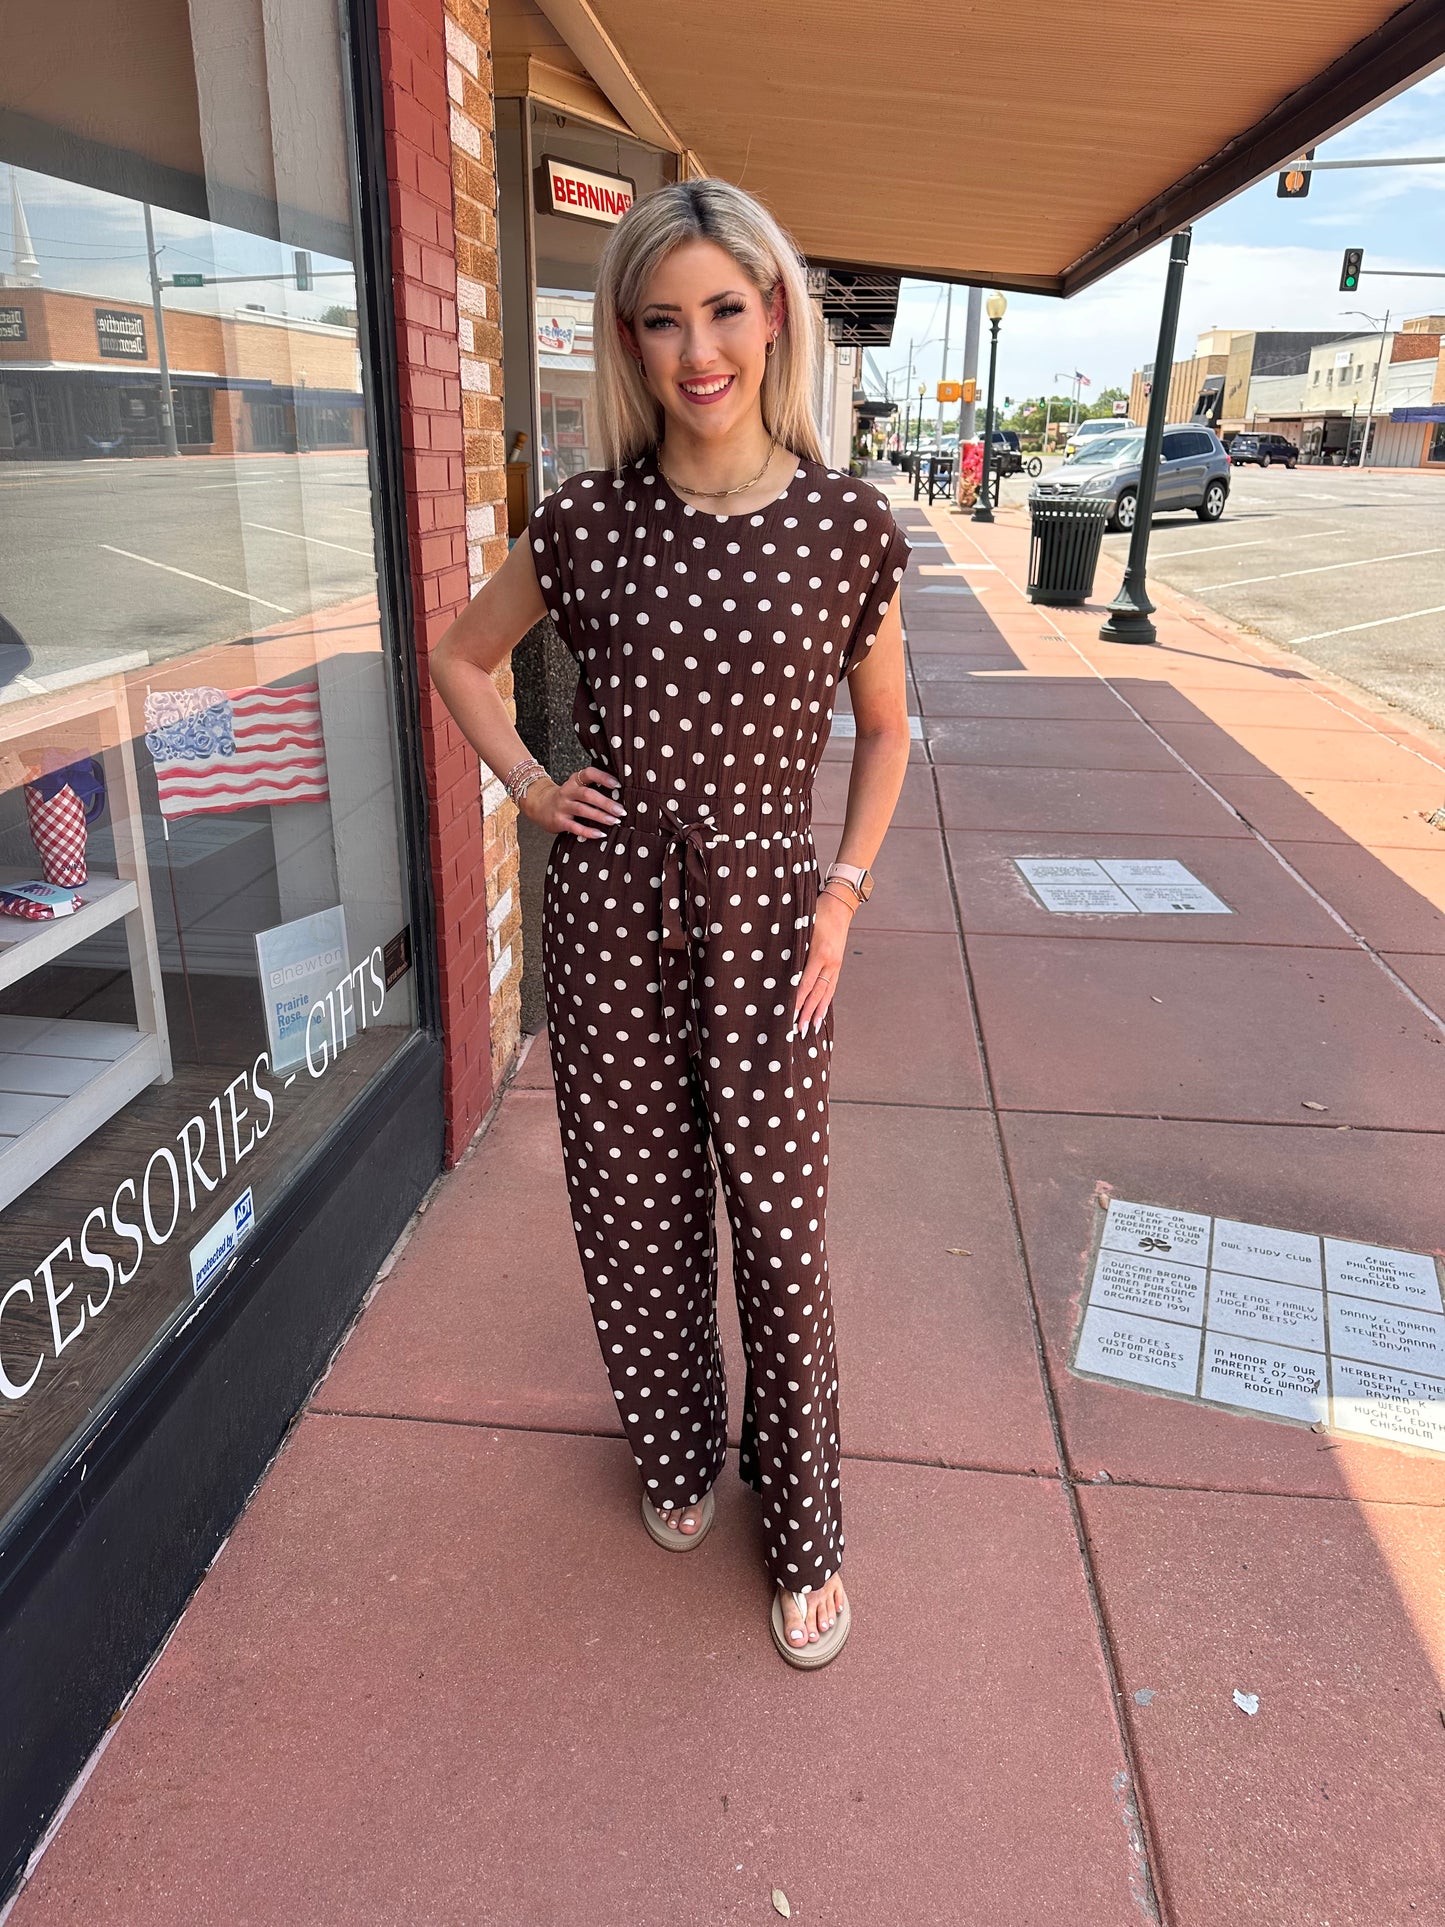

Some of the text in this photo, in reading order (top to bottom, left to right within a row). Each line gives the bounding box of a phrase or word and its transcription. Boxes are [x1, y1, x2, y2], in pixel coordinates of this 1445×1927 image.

[553, 175, 626, 215] BERNINA
[276, 993, 309, 1015] Prairie
[277, 1011, 301, 1027] Rose
[0, 1051, 274, 1400] CESSORIES
[306, 946, 385, 1079] GIFTS
[235, 1196, 252, 1228] ADT
[1112, 1211, 1205, 1233] FOUR LEAF CLOVER
[1114, 1218, 1201, 1239] FEDERATED CLUB
[1115, 1225, 1198, 1245] ORGANIZED 1920
[195, 1233, 234, 1287] protected by
[1221, 1241, 1312, 1263] OWL STUDY CLUB
[1102, 1267, 1198, 1290] INVESTMENT CLUB
[1111, 1261, 1191, 1282] DUNCAN BROAD
[1346, 1260, 1416, 1279] PHILOMATHIC
[1368, 1272, 1396, 1282] CLUB
[1102, 1274, 1196, 1298] WOMEN PURSUING
[1111, 1284, 1183, 1304] INVESTMENTS
[1340, 1273, 1427, 1295] ORGANIZED 1912
[1103, 1290, 1190, 1313] ORGANIZED 1991
[1215, 1297, 1248, 1309] JUDGE
[1283, 1309, 1318, 1322] BECKY
[1219, 1290, 1315, 1313] THE ENOS FAMILY
[1235, 1309, 1297, 1325] AND BETSY
[1340, 1309, 1377, 1321] DANNY
[1098, 1336, 1184, 1361] CUSTOM ROBES
[1113, 1331, 1170, 1349] DEE DEE'S
[1371, 1339, 1410, 1353] SONYA
[1101, 1347, 1177, 1369] AND DESIGNS
[1214, 1349, 1316, 1376] IN HONOR OF OUR
[1215, 1357, 1265, 1375] PARENTS
[1211, 1366, 1318, 1395] MURREL & WANDA
[1244, 1382, 1284, 1397] RODEN
[1340, 1366, 1393, 1383] HERBERT
[1414, 1381, 1445, 1394] ETHE
[1357, 1379, 1401, 1394] JOSEPH
[1408, 1389, 1416, 1397] D
[1366, 1389, 1410, 1405] RAYMA
[1354, 1405, 1388, 1419] HUGH
[1410, 1418, 1445, 1431] EDITH
[1378, 1401, 1420, 1416] WEEDN
[1370, 1419, 1433, 1439] CHISHOLM
